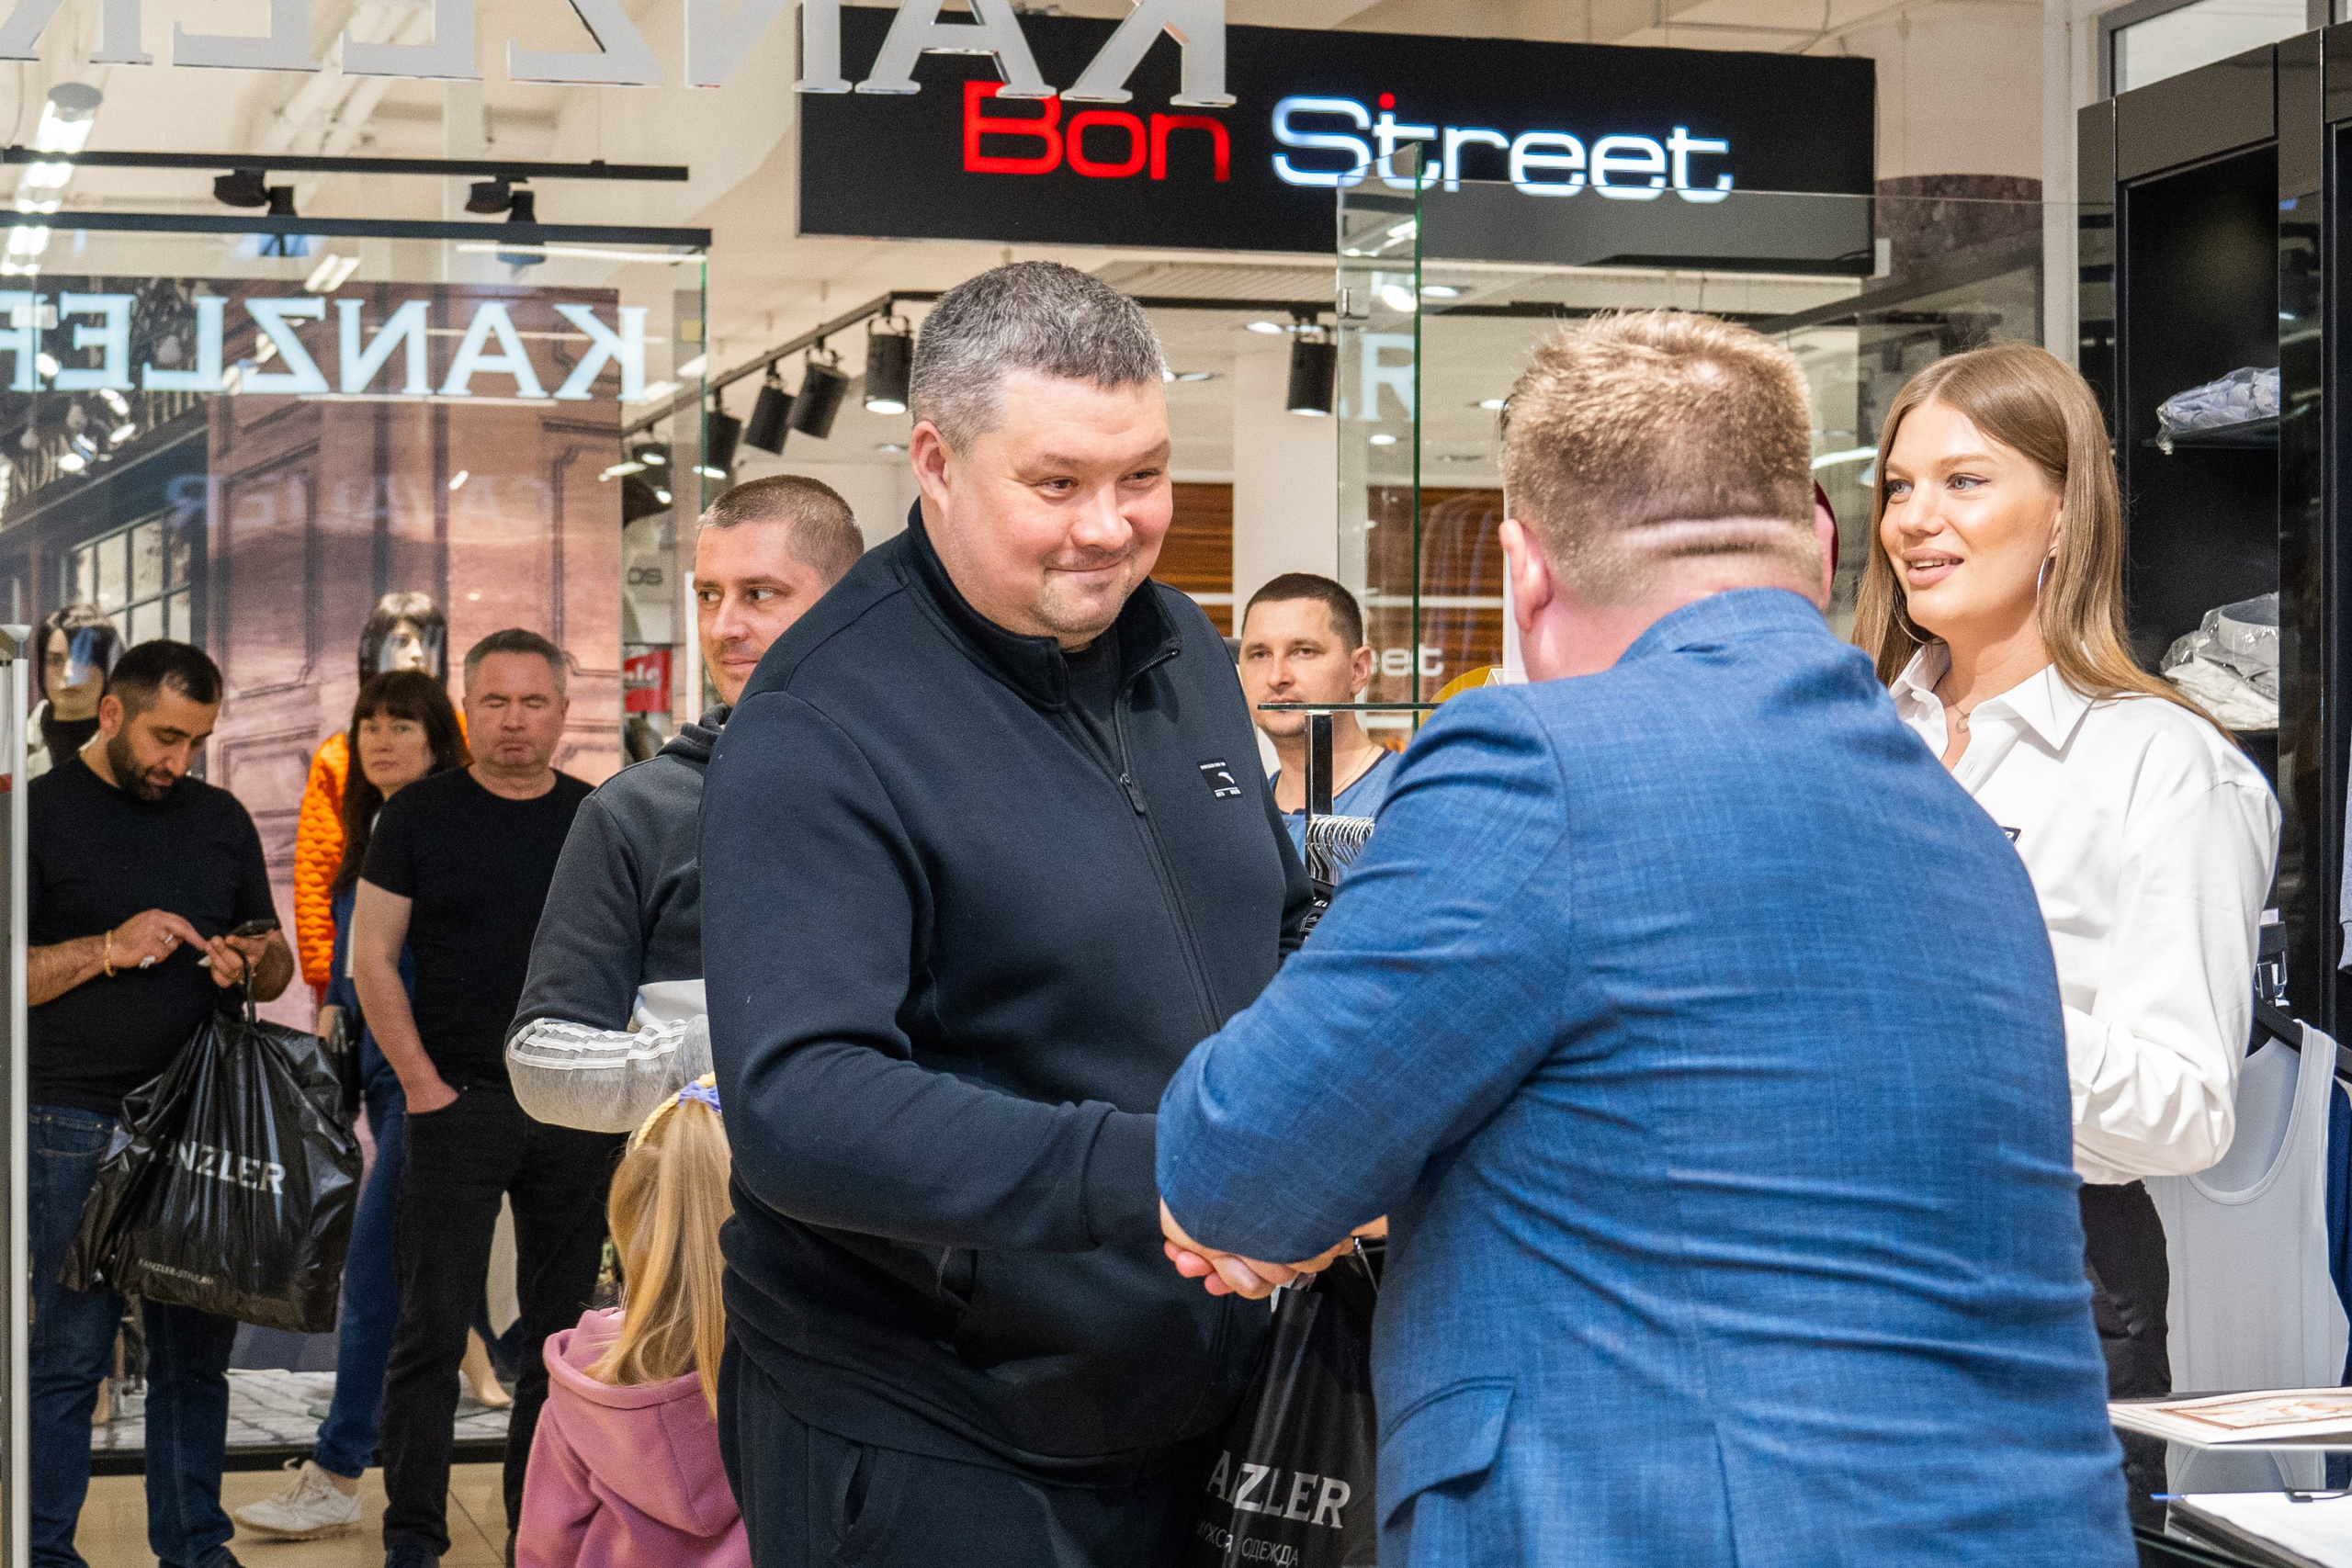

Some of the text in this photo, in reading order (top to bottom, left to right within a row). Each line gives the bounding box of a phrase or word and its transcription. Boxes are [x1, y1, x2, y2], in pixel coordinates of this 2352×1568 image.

[963, 80, 1735, 203] Bon Street
[1204, 1450, 1351, 1529] AZLER
[1240, 1536, 1300, 1567] ОДЕЖДА
